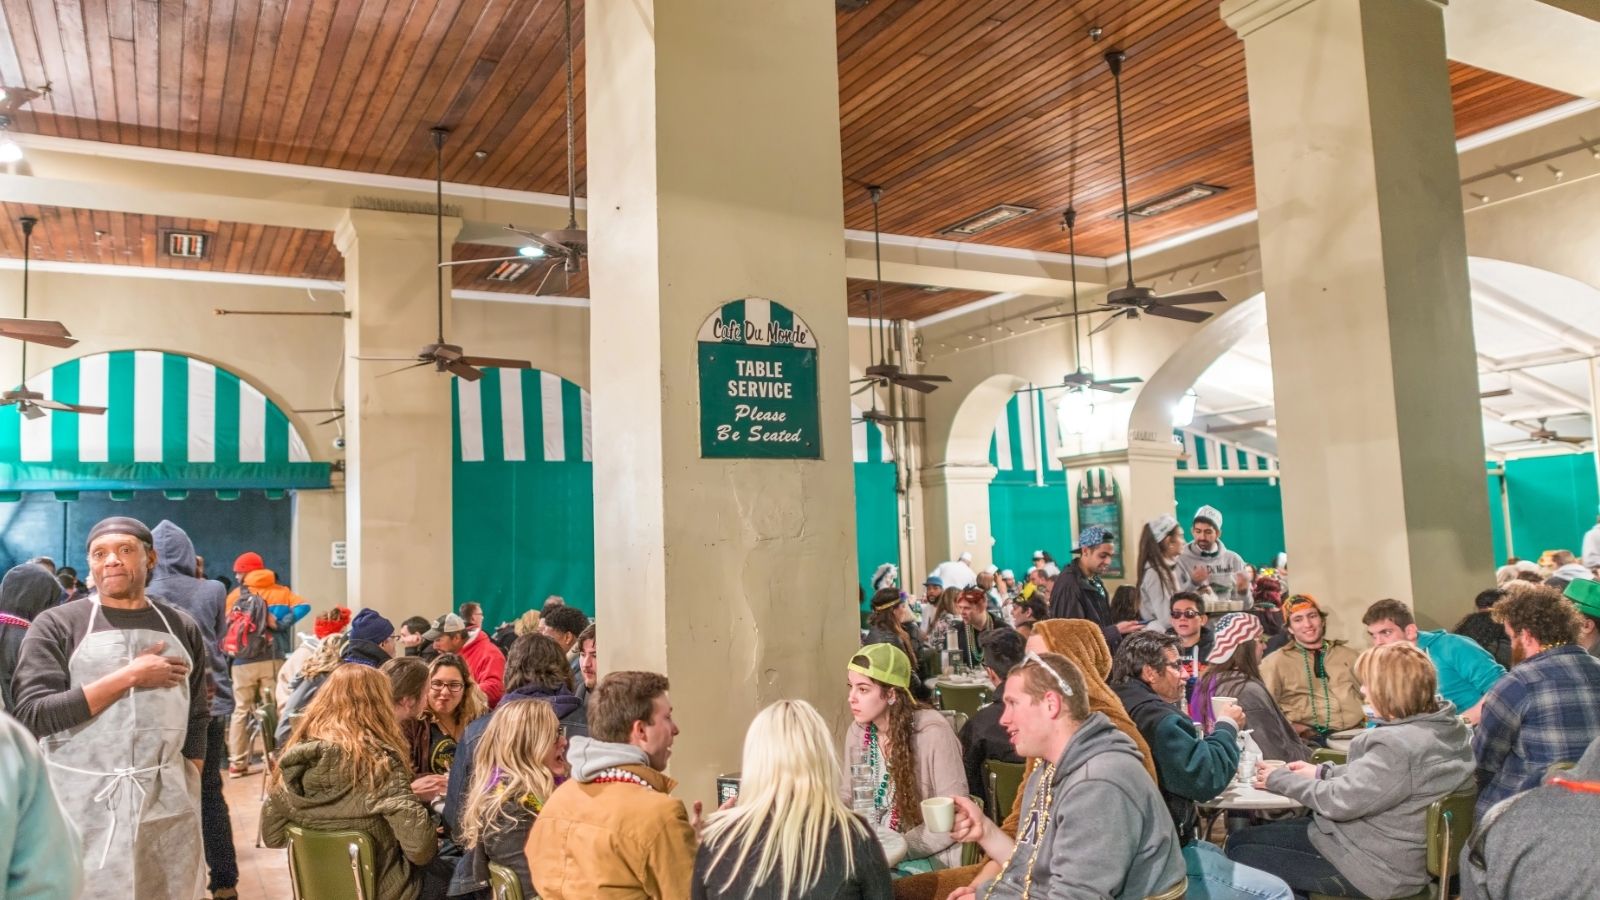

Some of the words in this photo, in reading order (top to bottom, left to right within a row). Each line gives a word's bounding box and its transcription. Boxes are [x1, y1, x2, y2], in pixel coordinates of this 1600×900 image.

[713, 318, 741, 340] Café
[744, 320, 763, 341] Du
[766, 321, 807, 344] Monde
[736, 360, 783, 378] TABLE
[728, 380, 793, 399] SERVICE
[735, 404, 787, 422] Please
[717, 424, 741, 441] Be
[748, 425, 802, 442] Seated
